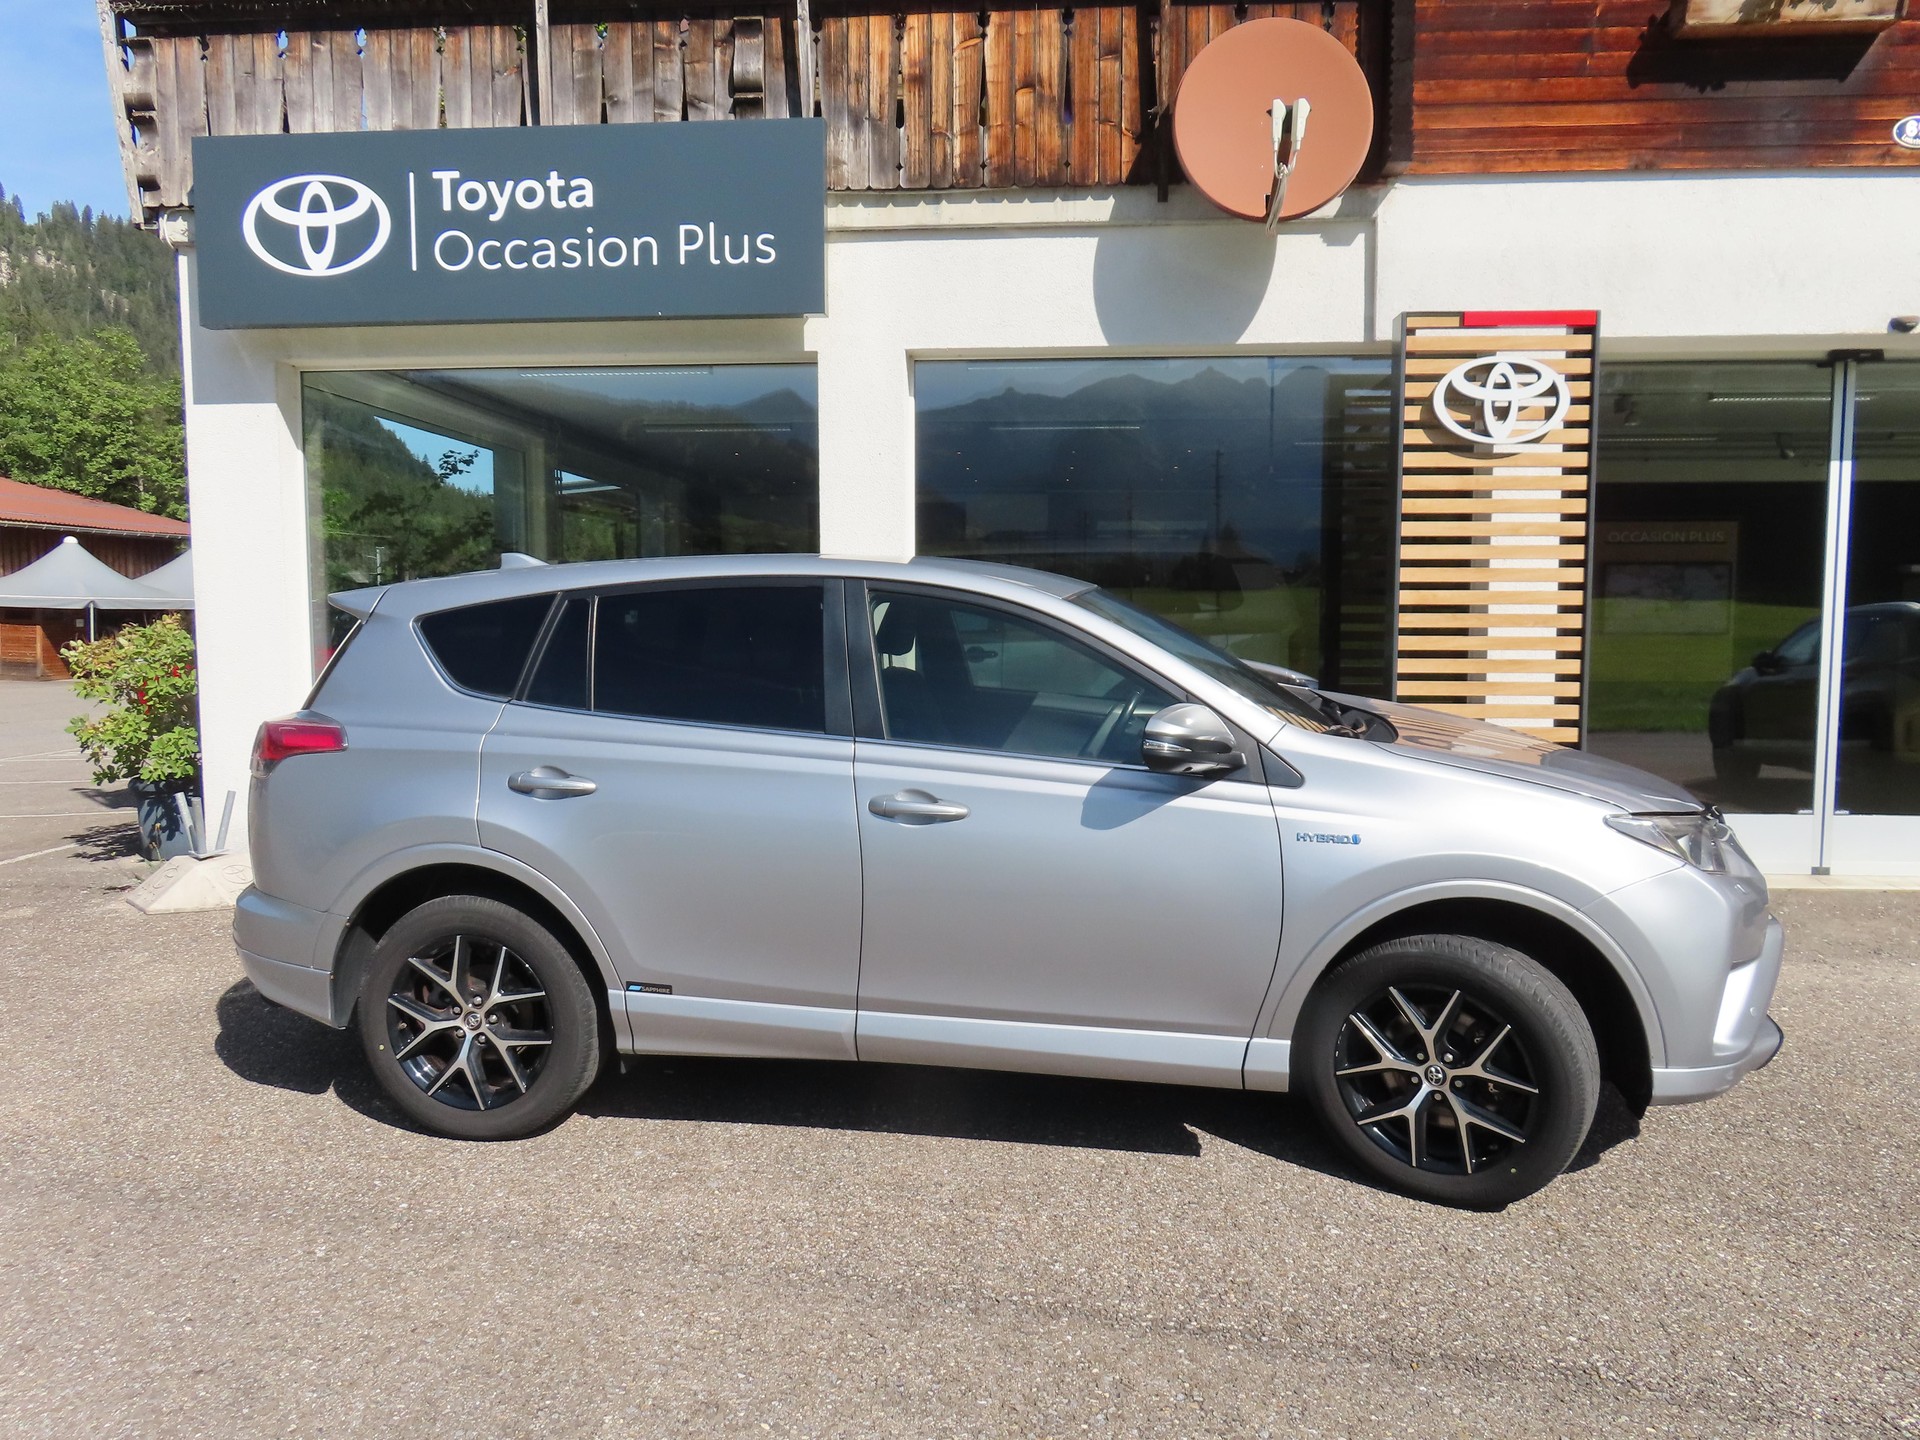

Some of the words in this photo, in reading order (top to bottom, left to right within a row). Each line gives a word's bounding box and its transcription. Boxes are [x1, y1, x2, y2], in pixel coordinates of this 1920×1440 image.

[432, 169, 595, 222] Toyota
[433, 226, 658, 272] Occasion
[678, 221, 777, 266] Plus
[1608, 531, 1685, 543] OCCASION
[1689, 531, 1725, 542] PLUS
[1296, 832, 1351, 844] HYBRID
